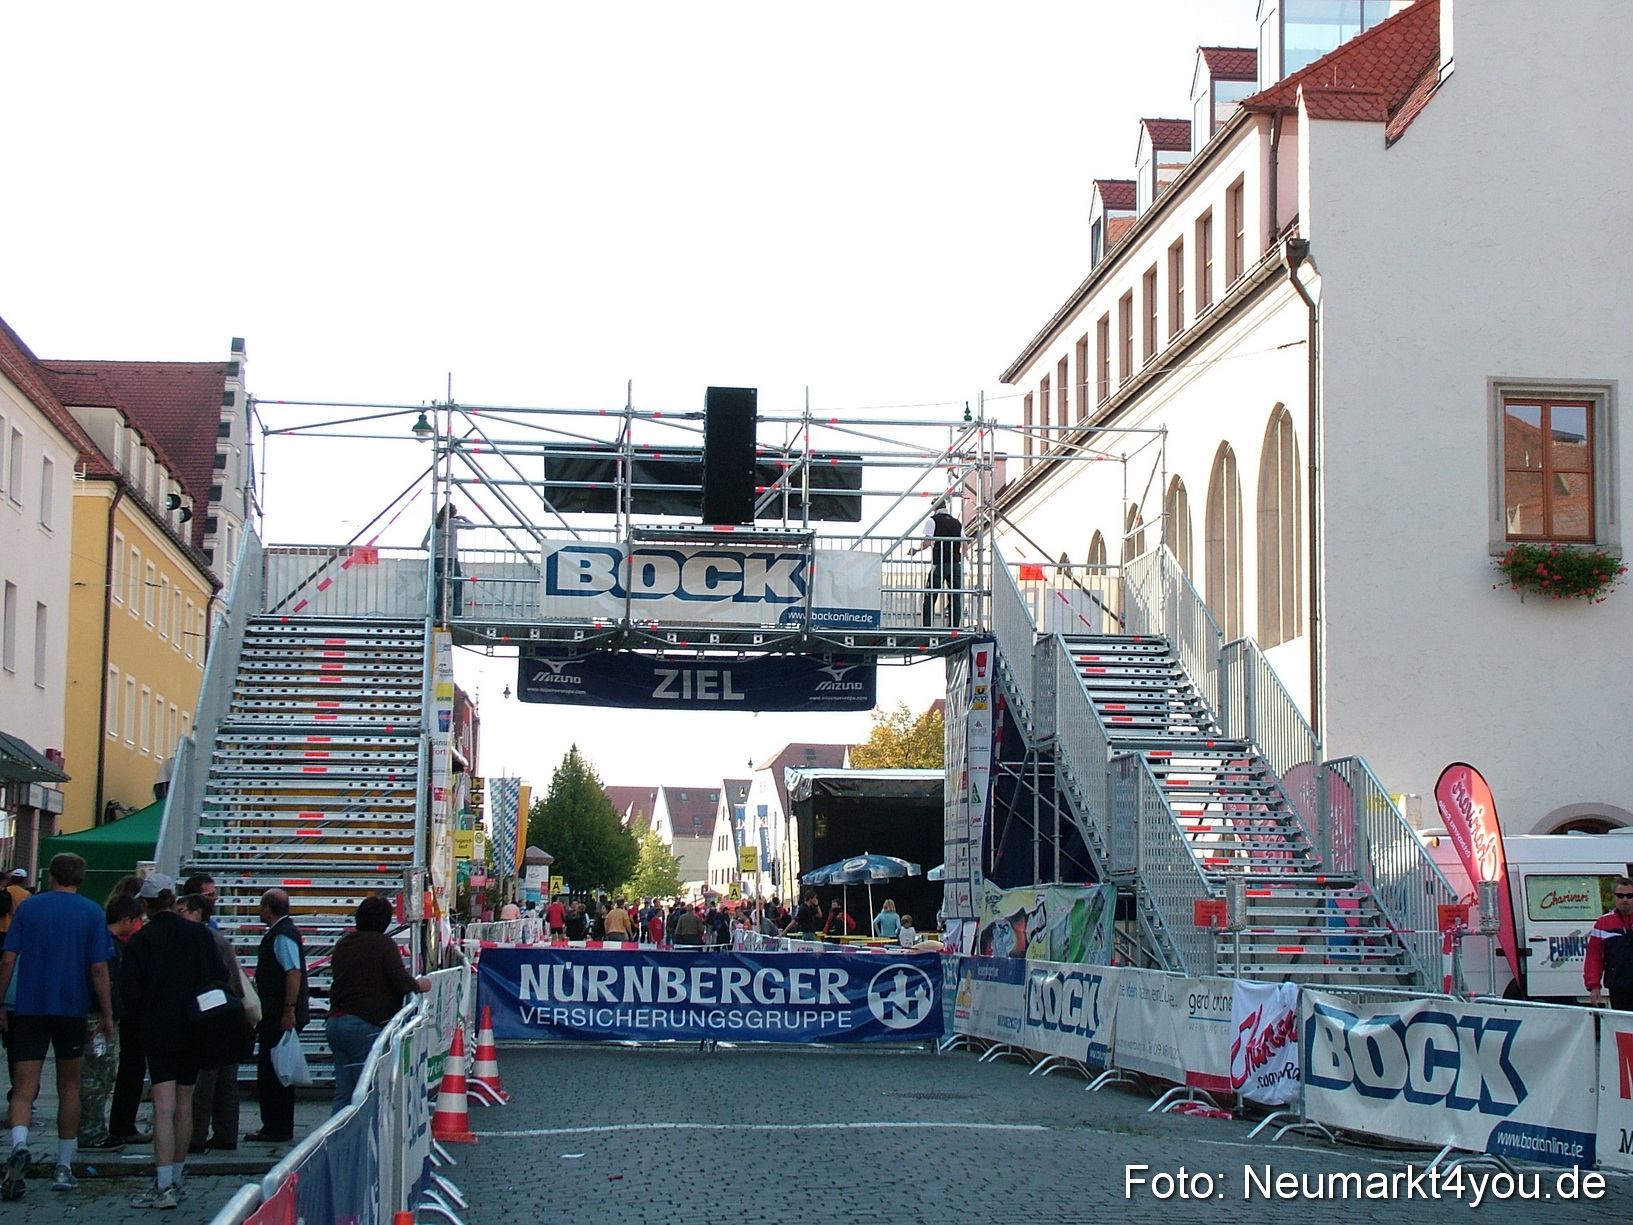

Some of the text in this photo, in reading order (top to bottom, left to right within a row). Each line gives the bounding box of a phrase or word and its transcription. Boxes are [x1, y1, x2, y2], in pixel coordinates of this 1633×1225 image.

[546, 545, 806, 604] BOCK
[532, 671, 582, 684] MIZUNO
[653, 669, 745, 700] ZIEL
[815, 681, 863, 691] MIZUNO
[553, 881, 560, 890] A
[731, 888, 738, 897] A
[1540, 890, 1590, 909] Charivari
[518, 962, 850, 1005] NÜRNBERGER
[1027, 969, 1103, 1038] BOCK
[1189, 989, 1209, 1015] gerd
[519, 1006, 852, 1029] VERSICHERUNGSGRUPPE
[1305, 1003, 1528, 1117] BOCK
[1497, 1131, 1584, 1159] www.bockonline.de
